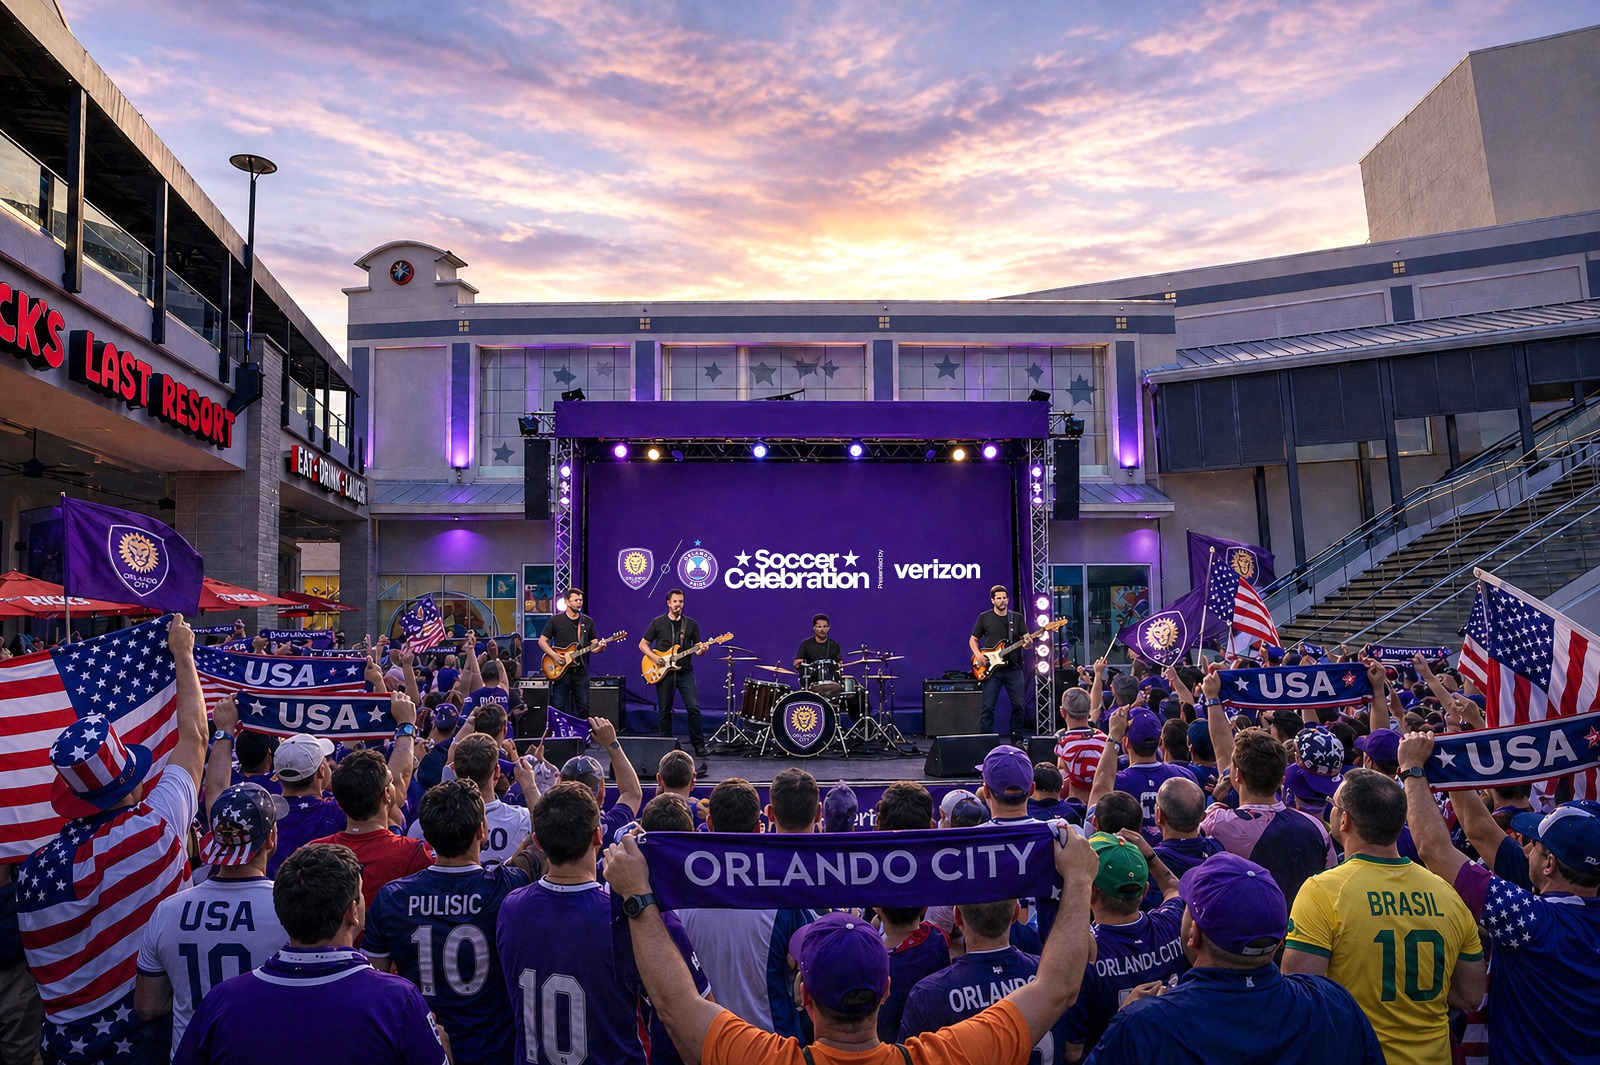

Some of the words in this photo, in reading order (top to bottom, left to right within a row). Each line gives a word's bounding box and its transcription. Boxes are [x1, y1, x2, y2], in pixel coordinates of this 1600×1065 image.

[85, 331, 152, 407] LAST
[162, 374, 235, 448] RESORT
[298, 446, 314, 479] EAT
[754, 548, 839, 569] Soccer
[893, 558, 981, 580] verizon
[724, 567, 870, 589] Celebration
[244, 660, 315, 687] USA
[1258, 670, 1336, 699] USA
[278, 701, 360, 731] USA
[1465, 728, 1579, 776] USA
[684, 850, 918, 887] ORLANDO
[931, 841, 1037, 881] CITY
[180, 901, 256, 932] USA
[408, 893, 482, 916] PULISIC
[1367, 891, 1445, 917] BRASIL
[411, 924, 490, 997] 10
[1373, 929, 1445, 1002] 10
[179, 943, 252, 1010] 10
[519, 968, 588, 1065] 10
